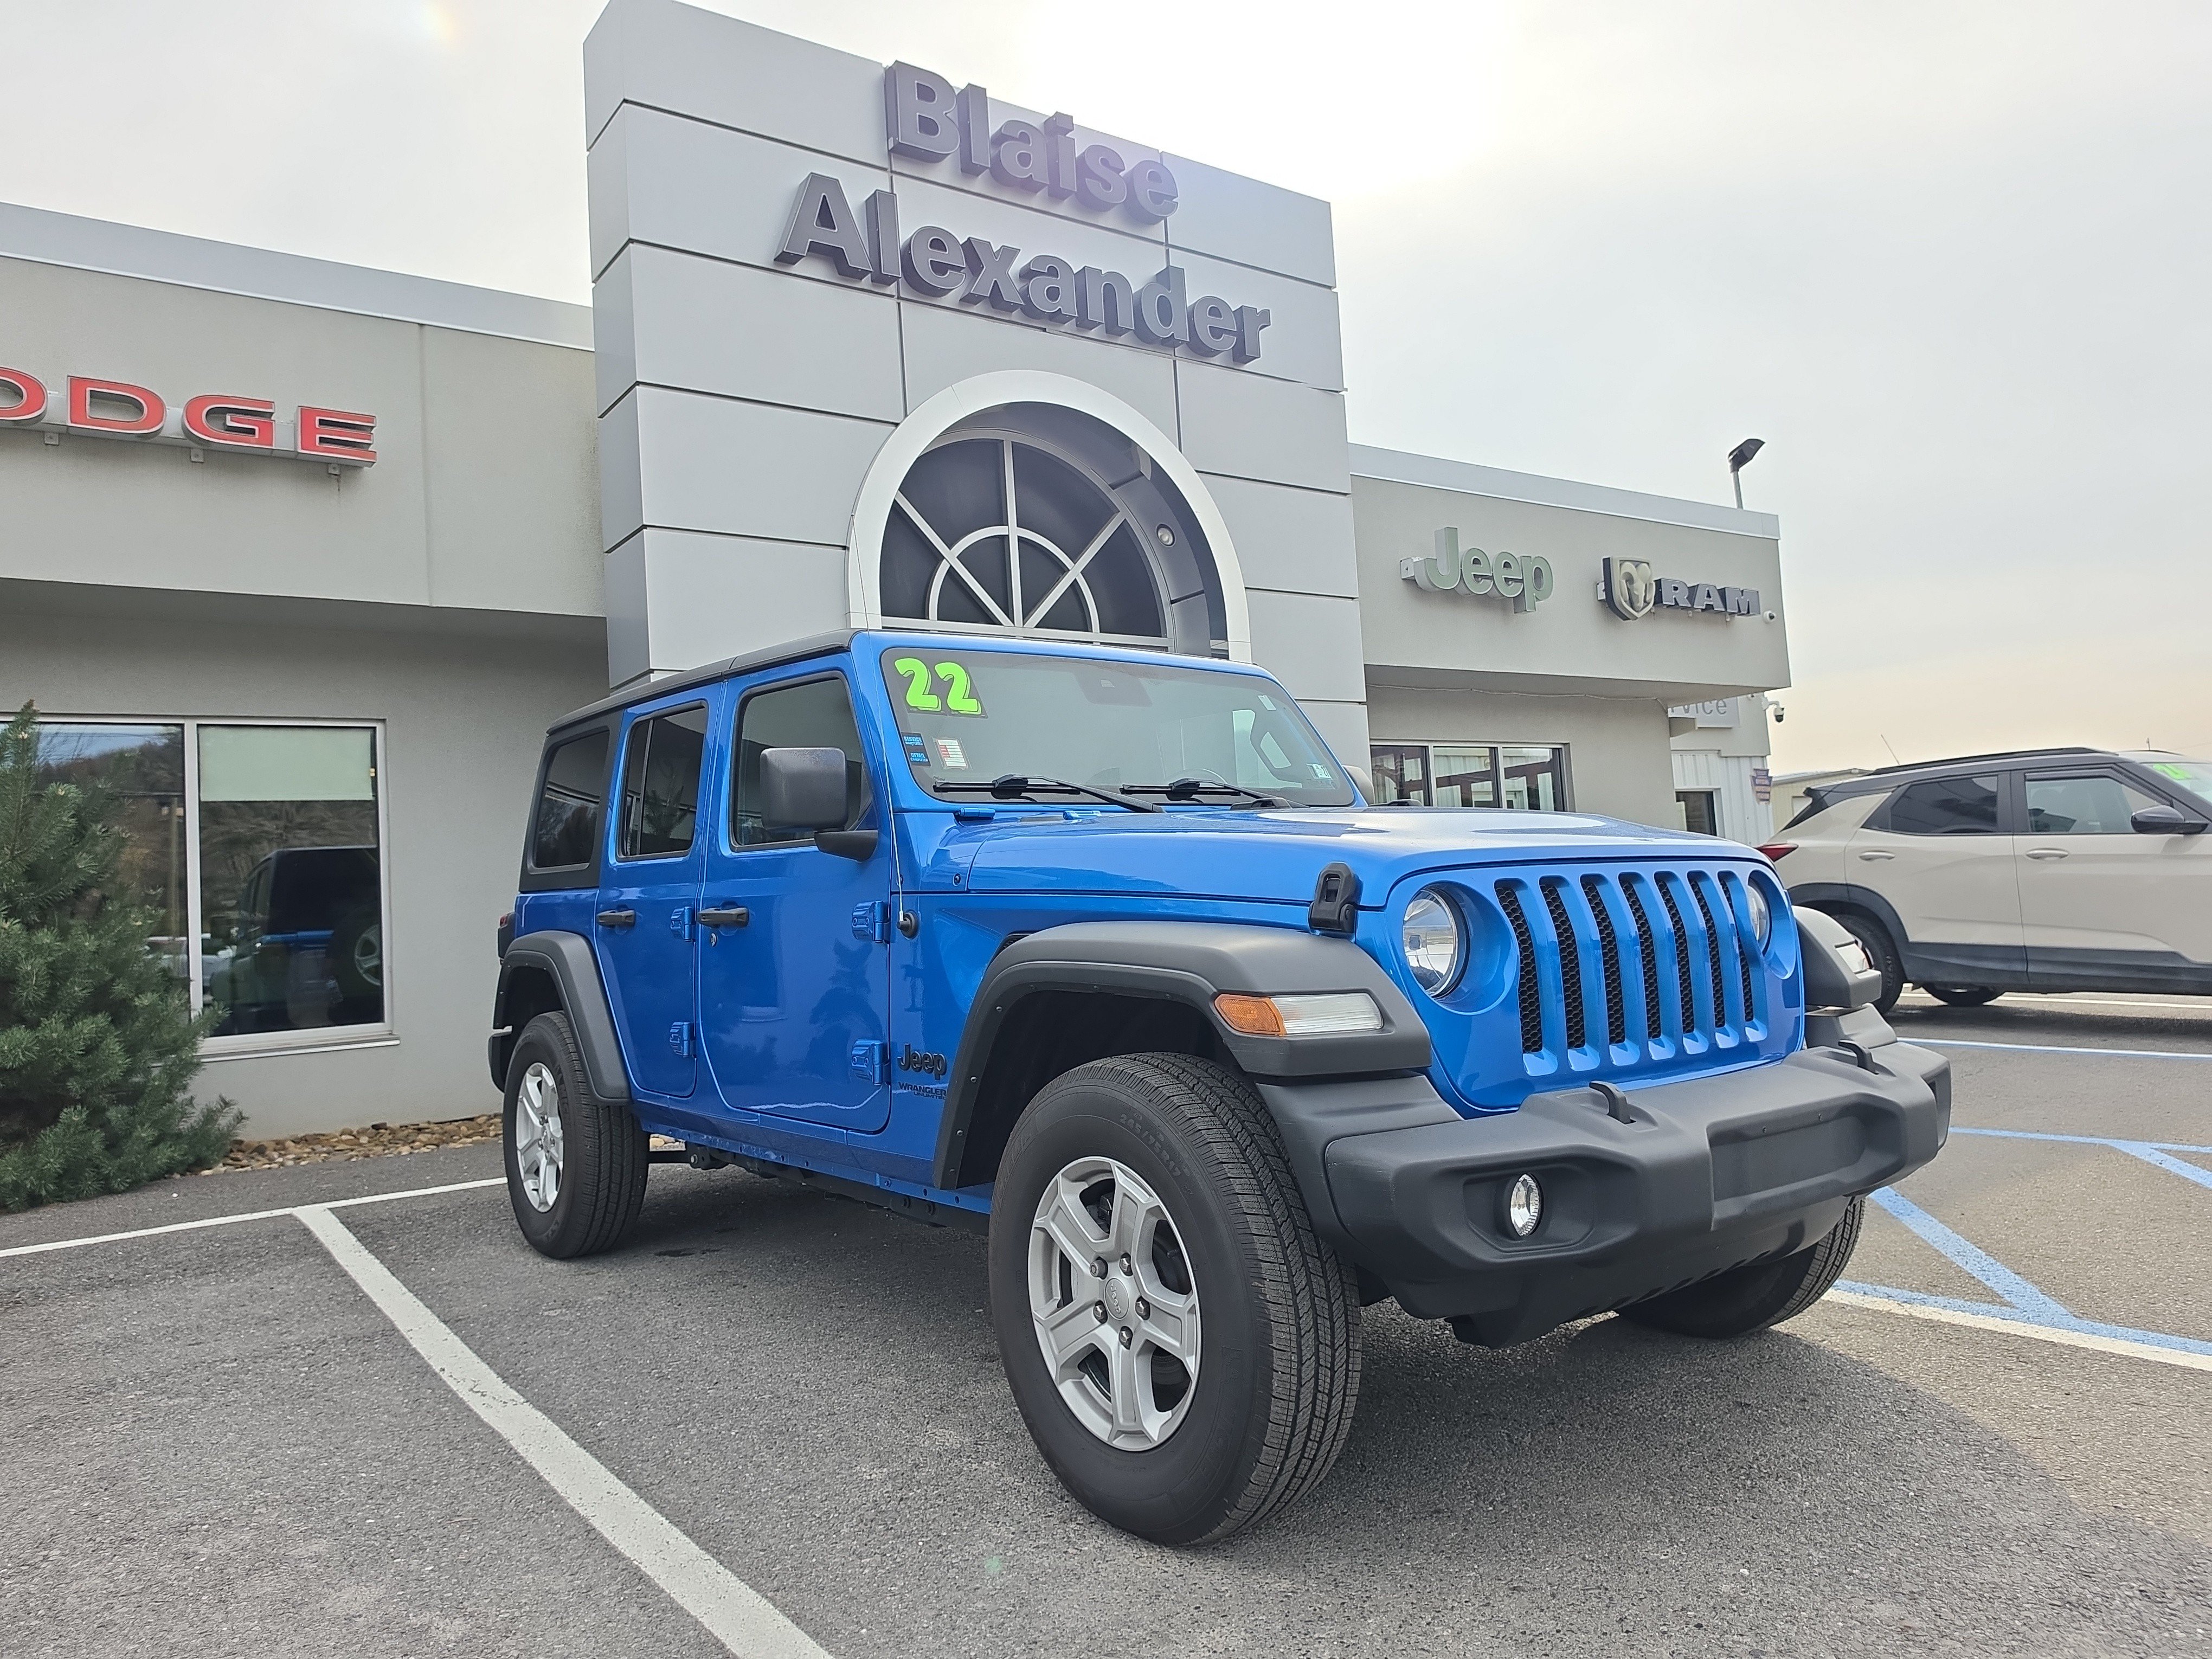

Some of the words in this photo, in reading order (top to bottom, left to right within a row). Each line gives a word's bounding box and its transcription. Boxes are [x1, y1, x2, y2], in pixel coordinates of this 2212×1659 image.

[885, 60, 1179, 224] Blaise
[774, 172, 1271, 365] Alexander
[1413, 526, 1554, 614] Jeep
[1654, 577, 1760, 616] RAM
[894, 657, 982, 715] 22
[897, 1043, 947, 1081] Jeep
[898, 1081, 947, 1097] WRANGLER
[1119, 1113, 1182, 1177] 245/75R17
[1110, 1282, 1122, 1314] Jeep
